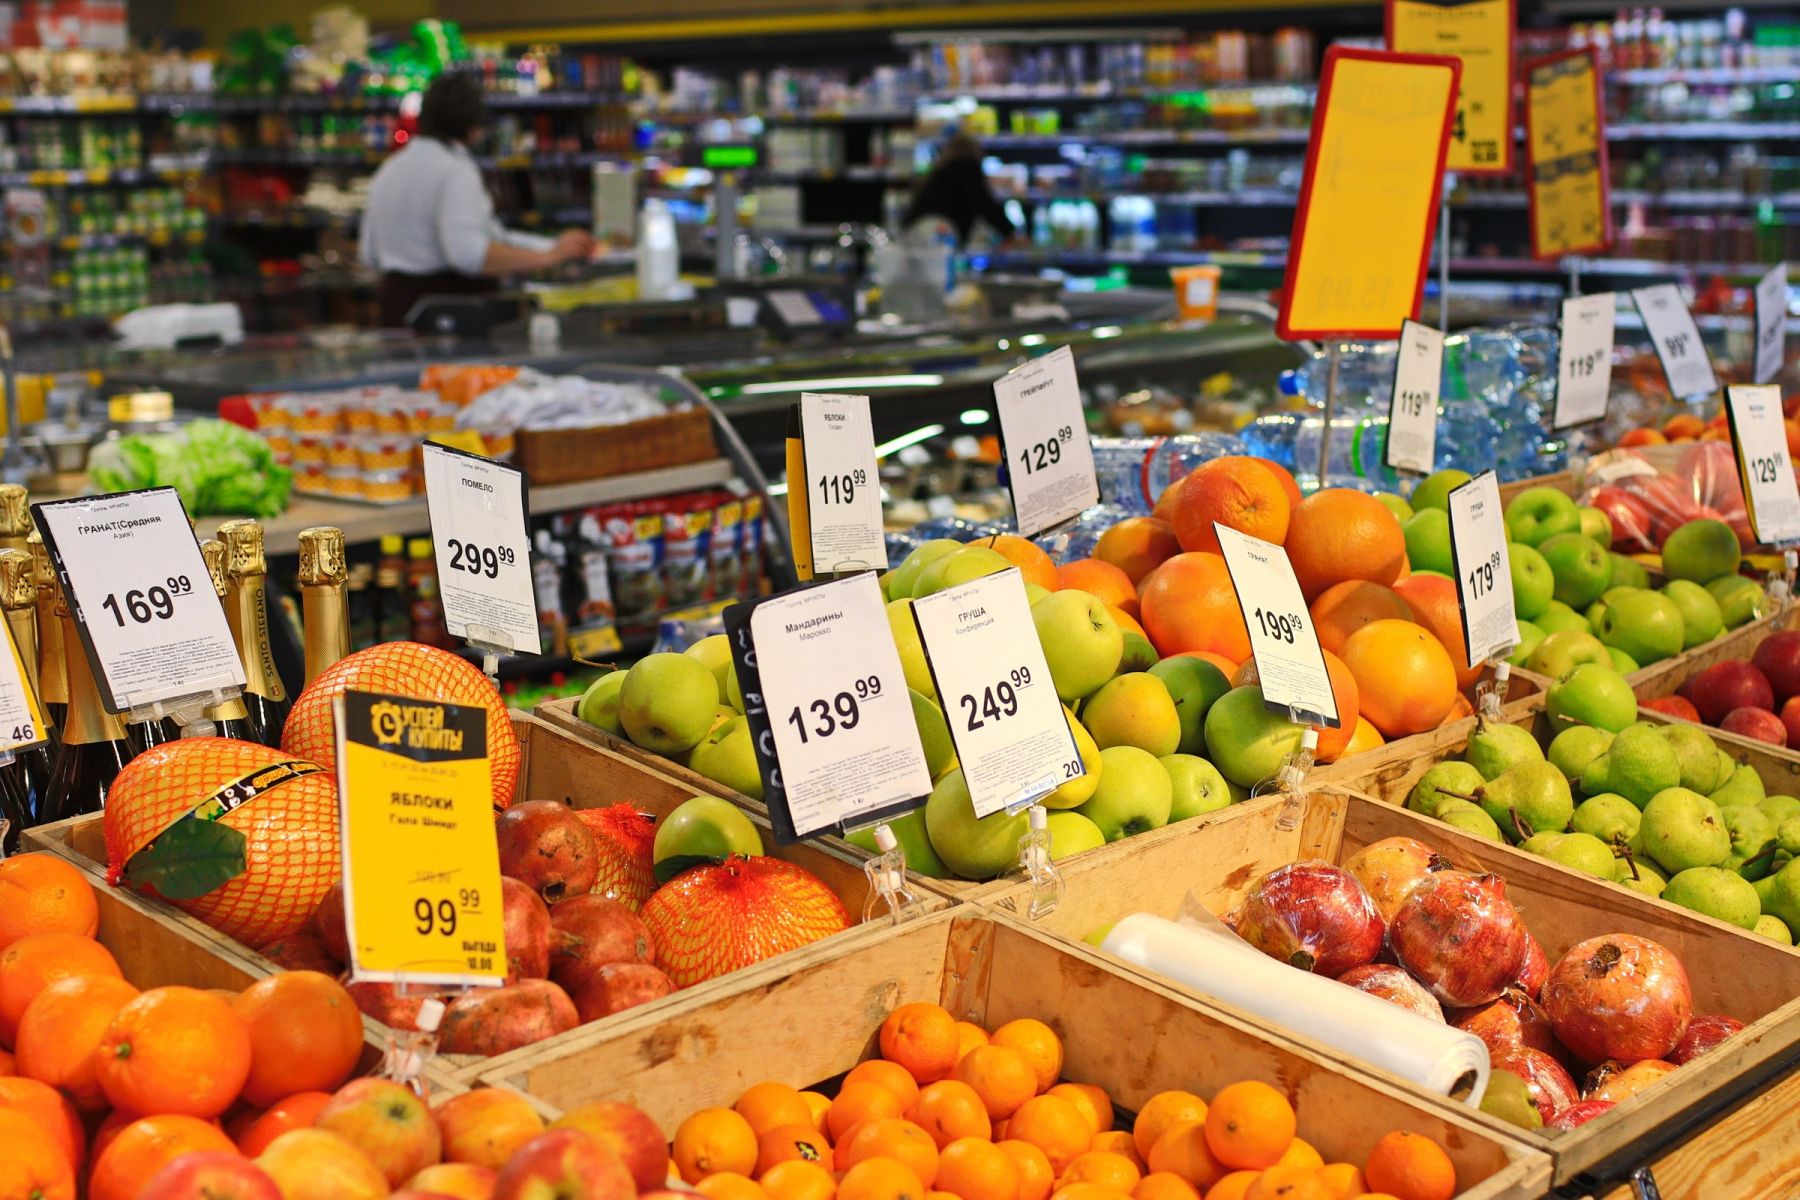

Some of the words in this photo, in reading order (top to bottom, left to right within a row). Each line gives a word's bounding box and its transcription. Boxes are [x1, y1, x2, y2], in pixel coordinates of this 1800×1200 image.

[1569, 355, 1595, 378] 119
[1401, 389, 1423, 417] 119
[1020, 437, 1061, 475] 129
[1057, 425, 1072, 442] 99
[1751, 457, 1777, 483] 129
[461, 477, 494, 493] ПОМЕЛО
[819, 474, 855, 505] 119
[853, 468, 866, 484] 99
[77, 514, 162, 536] ГРАНАТ(Средняя
[113, 530, 134, 540] Азия)
[447, 538, 499, 579] 299
[498, 545, 516, 564] 99
[1469, 562, 1494, 600] 179
[1491, 551, 1501, 569] 99
[103, 584, 175, 627] 169
[166, 575, 193, 594] 99
[255, 588, 267, 639] STEFANO
[958, 606, 987, 623] ГРУША
[785, 610, 844, 634] Мандарины
[799, 627, 832, 642] Марокко
[1254, 607, 1295, 645] 199
[1288, 613, 1304, 630] 99
[260, 643, 274, 677] SANTO
[788, 691, 860, 744] 139
[855, 675, 882, 699] 99
[960, 681, 1019, 733] 249
[1010, 666, 1032, 689] 99
[11, 724, 34, 743] 46
[1063, 760, 1080, 778] 20
[390, 791, 454, 810] ЯБЛОКИ
[414, 897, 457, 937] 99
[459, 888, 481, 908] 99
